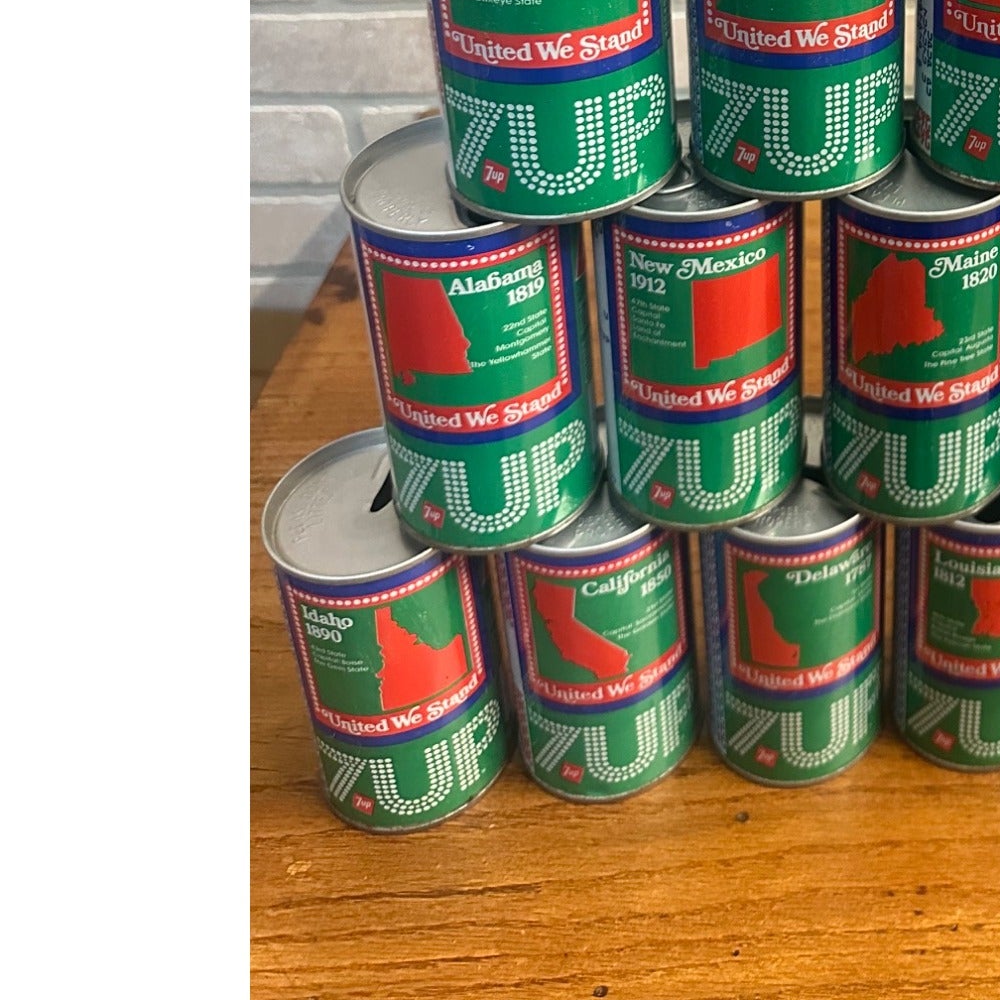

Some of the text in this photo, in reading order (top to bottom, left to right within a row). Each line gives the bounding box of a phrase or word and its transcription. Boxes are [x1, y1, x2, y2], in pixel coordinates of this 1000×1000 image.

[715, 12, 888, 50] United We Stand
[445, 74, 667, 196] 7UP
[967, 133, 987, 154] 7up
[735, 146, 756, 165] 7up
[483, 165, 506, 185] 7up
[448, 259, 543, 295] Alabama
[629, 248, 767, 279] New Mexico
[928, 246, 999, 279] Maine
[962, 263, 998, 290] 1820
[507, 276, 545, 307] 1819
[630, 273, 666, 295] 1912
[527, 309, 547, 322] State
[489, 337, 551, 365] Yellowhammer
[495, 326, 549, 352] Montgomery
[845, 365, 999, 403] United We Stand
[392, 381, 562, 430] United We Stand
[390, 417, 587, 533] 7UP
[582, 550, 669, 596] California
[641, 564, 672, 597] 1850
[301, 604, 353, 629] Idaho
[306, 623, 342, 643] 1890
[321, 674, 478, 735] United We Stand
[316, 700, 500, 816] 7UP
